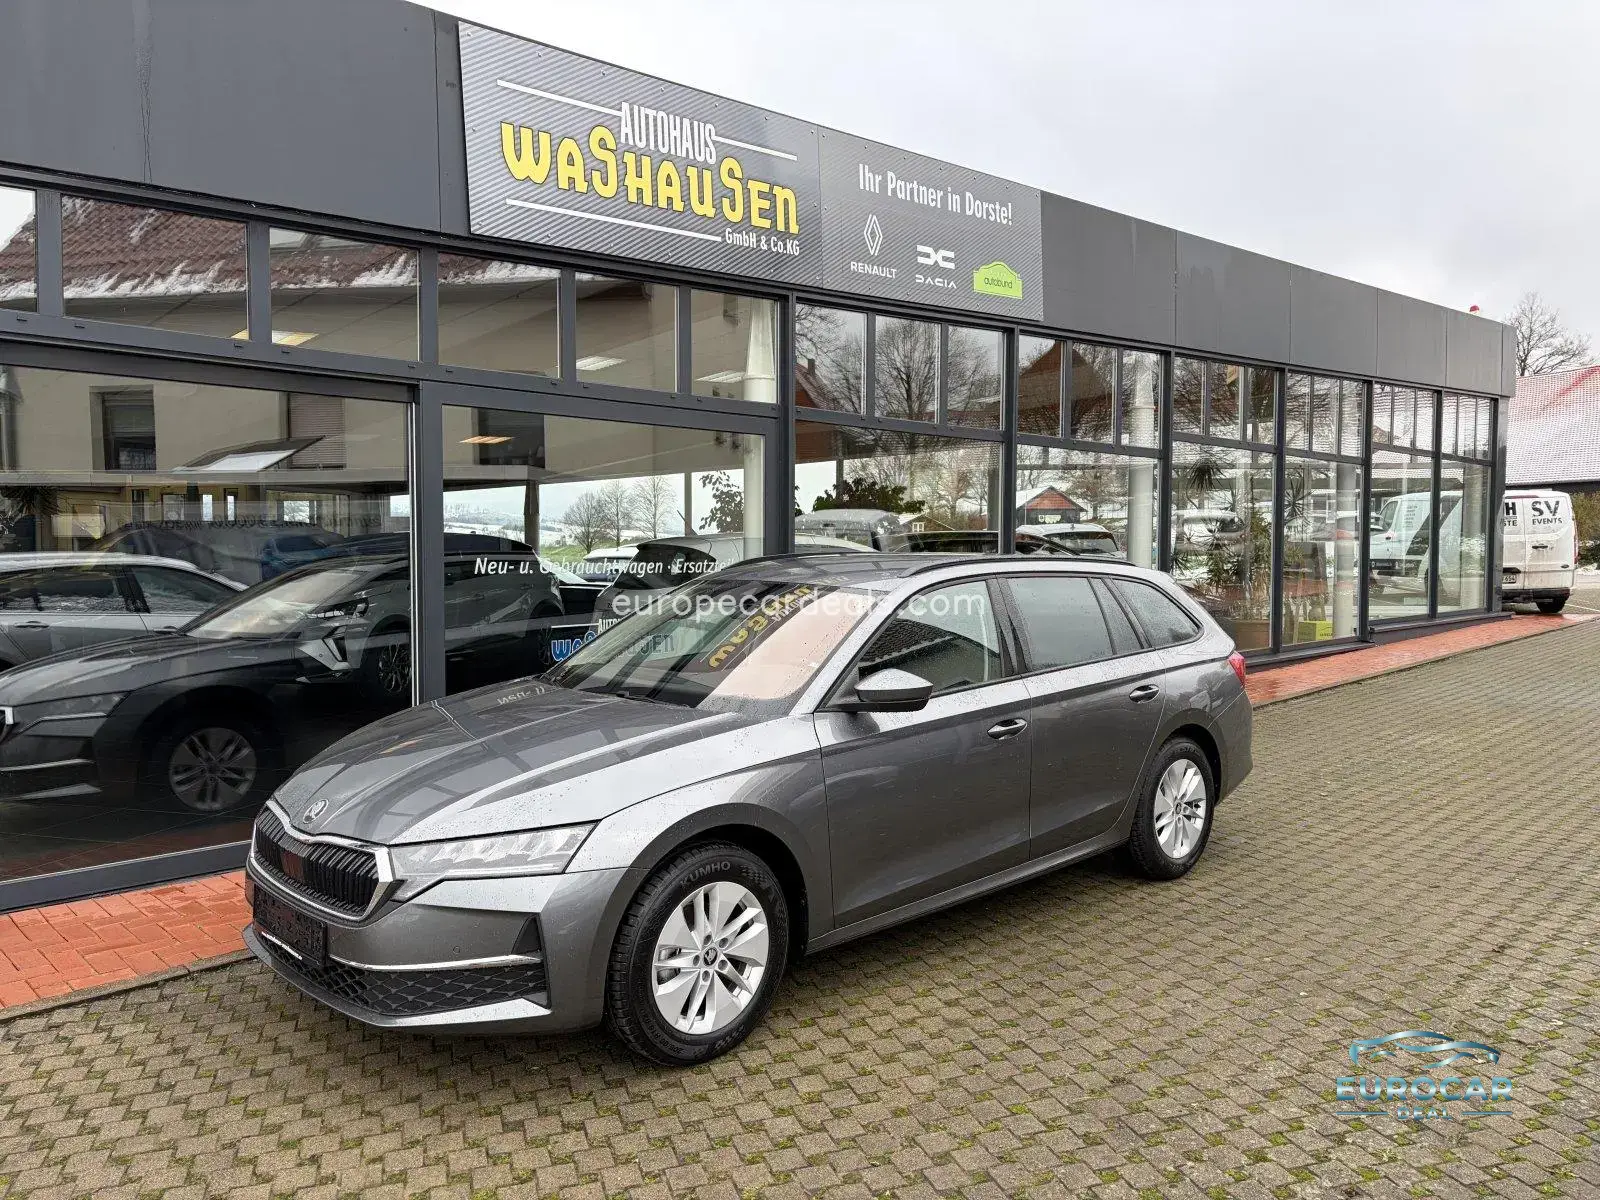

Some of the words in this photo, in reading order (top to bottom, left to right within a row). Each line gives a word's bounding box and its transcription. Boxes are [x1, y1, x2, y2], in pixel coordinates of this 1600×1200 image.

[620, 101, 716, 164] AUTOHAUS
[858, 163, 882, 193] Ihr
[887, 171, 943, 208] Partner
[947, 187, 961, 213] in
[965, 191, 1013, 226] Dorste!
[725, 228, 757, 249] GmbH
[760, 236, 768, 250] &
[850, 261, 897, 279] RENAULT
[915, 274, 957, 289] DACIA
[1532, 501, 1560, 516] SV
[475, 557, 514, 575] Neu-
[519, 561, 534, 574] u.
[680, 861, 731, 885] KUMHO
